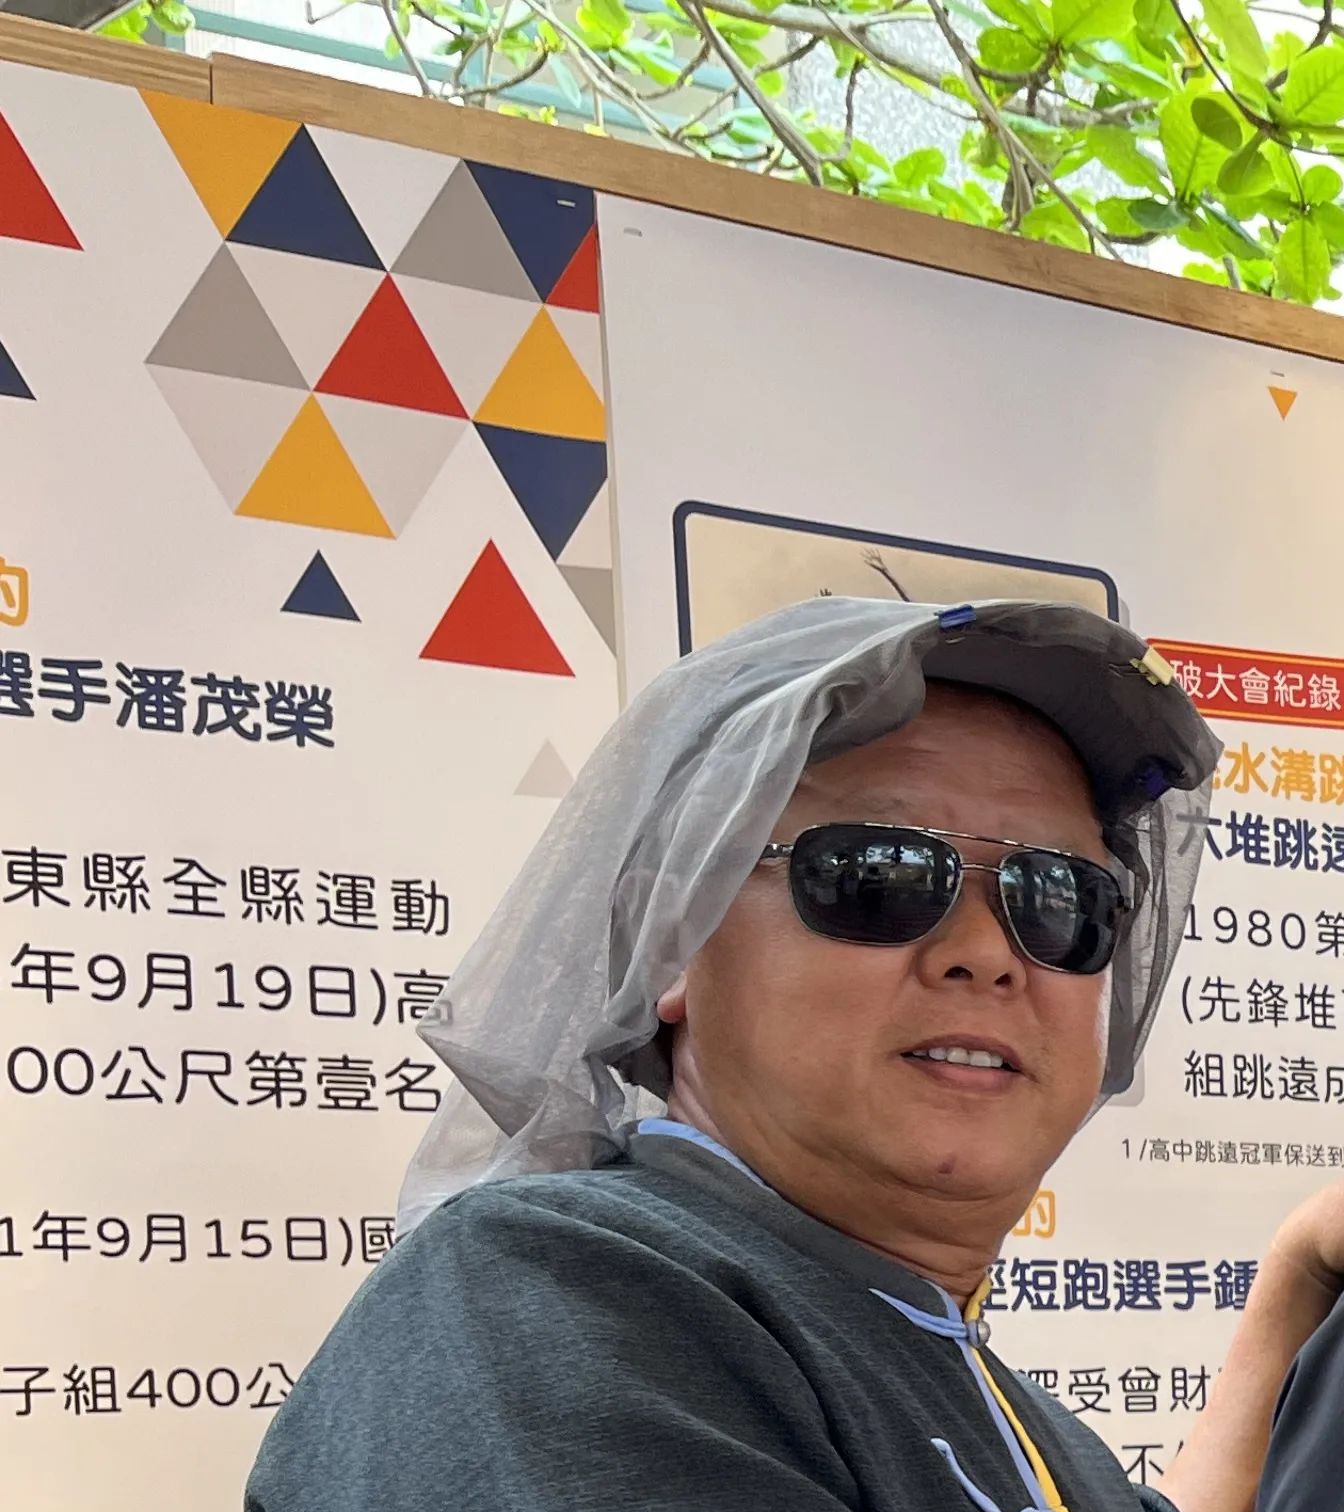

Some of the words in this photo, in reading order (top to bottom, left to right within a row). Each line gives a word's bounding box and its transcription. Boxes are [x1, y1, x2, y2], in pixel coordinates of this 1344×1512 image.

[2, 846, 450, 936] 東縣全縣運動
[7, 1045, 443, 1112] 00公尺第壹名
